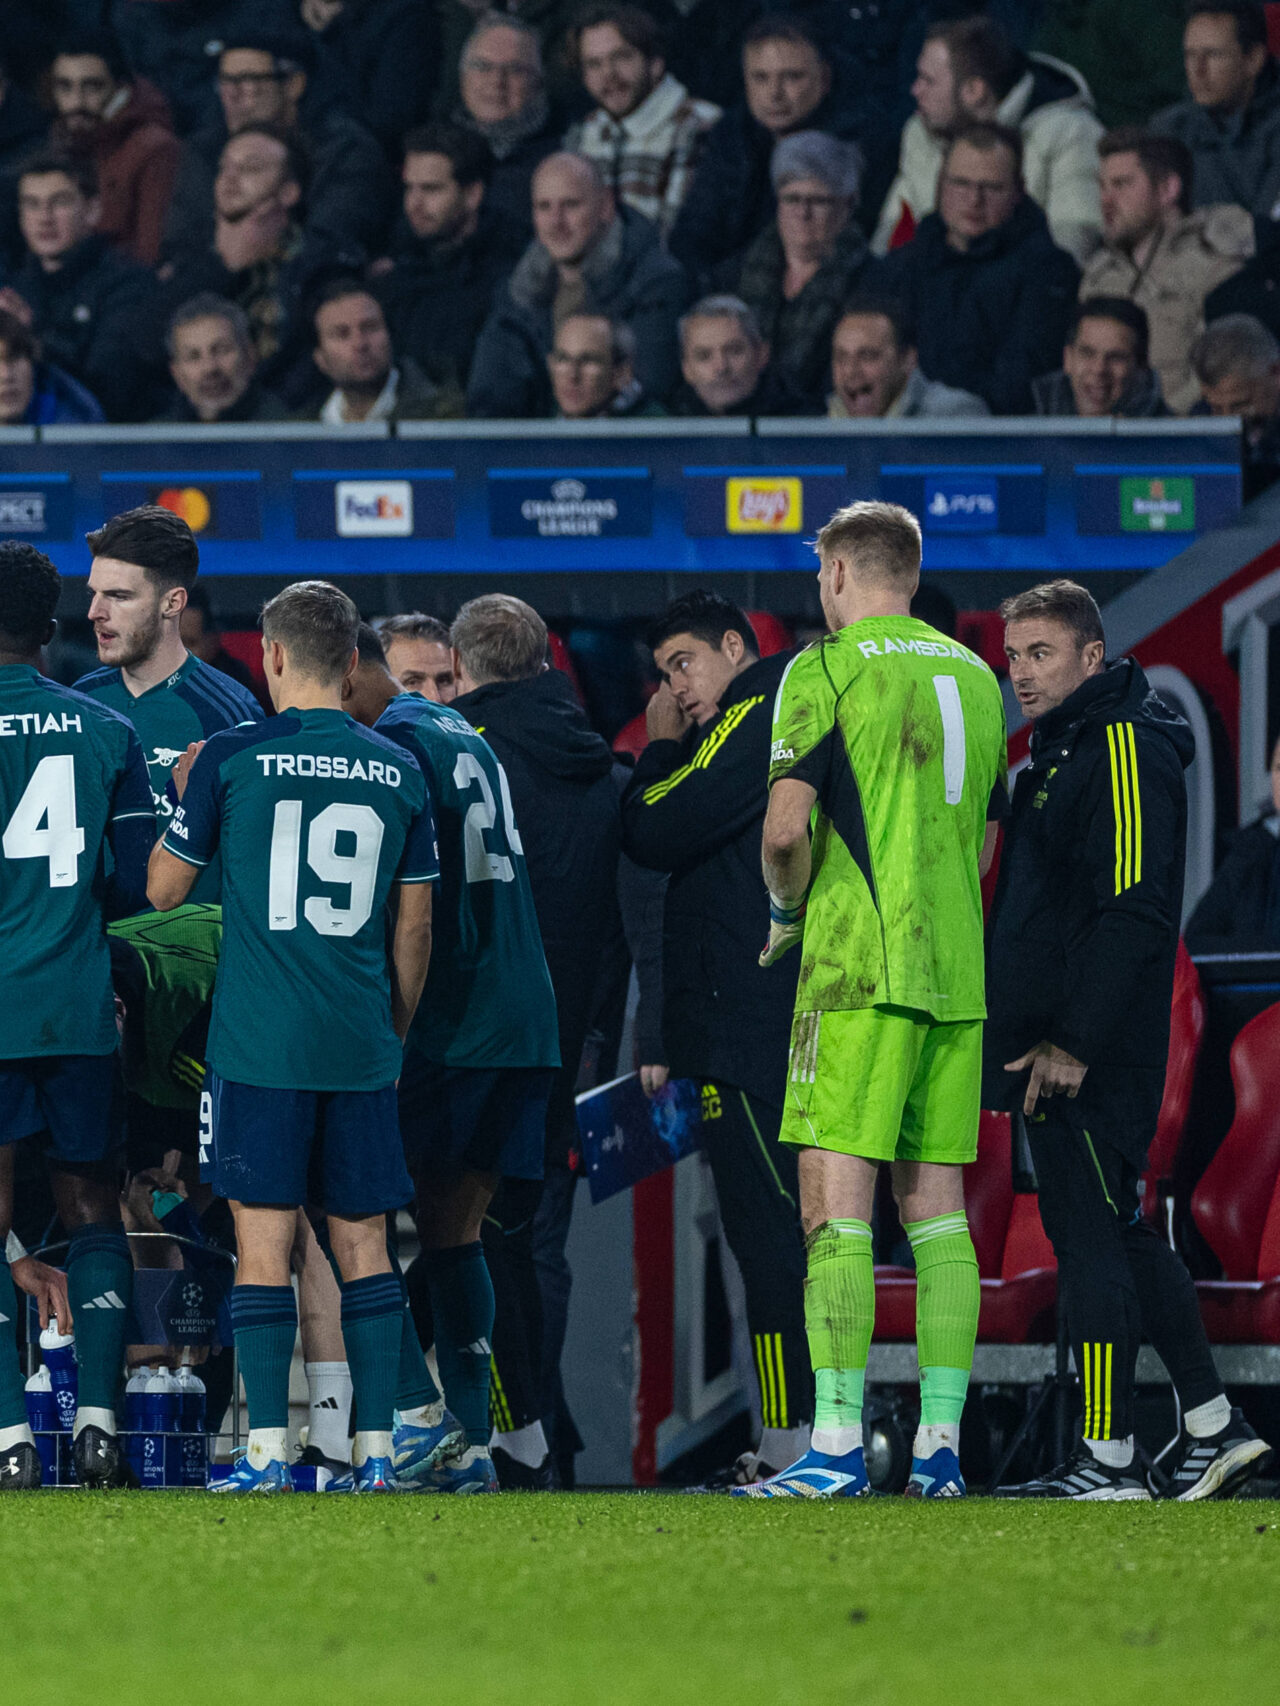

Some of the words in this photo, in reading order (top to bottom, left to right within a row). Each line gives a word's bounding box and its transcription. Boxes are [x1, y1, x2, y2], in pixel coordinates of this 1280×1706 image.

[345, 495, 404, 519] FedEx
[521, 499, 618, 519] CHAMPIONS
[538, 519, 601, 536] LEAGUE
[431, 716, 480, 737] NELS
[932, 674, 967, 806] 1
[256, 754, 402, 788] TROSSARD
[173, 805, 187, 821] SIT
[169, 818, 190, 841] NDA
[268, 799, 386, 938] 19
[169, 1318, 217, 1326] CHAMPIONS
